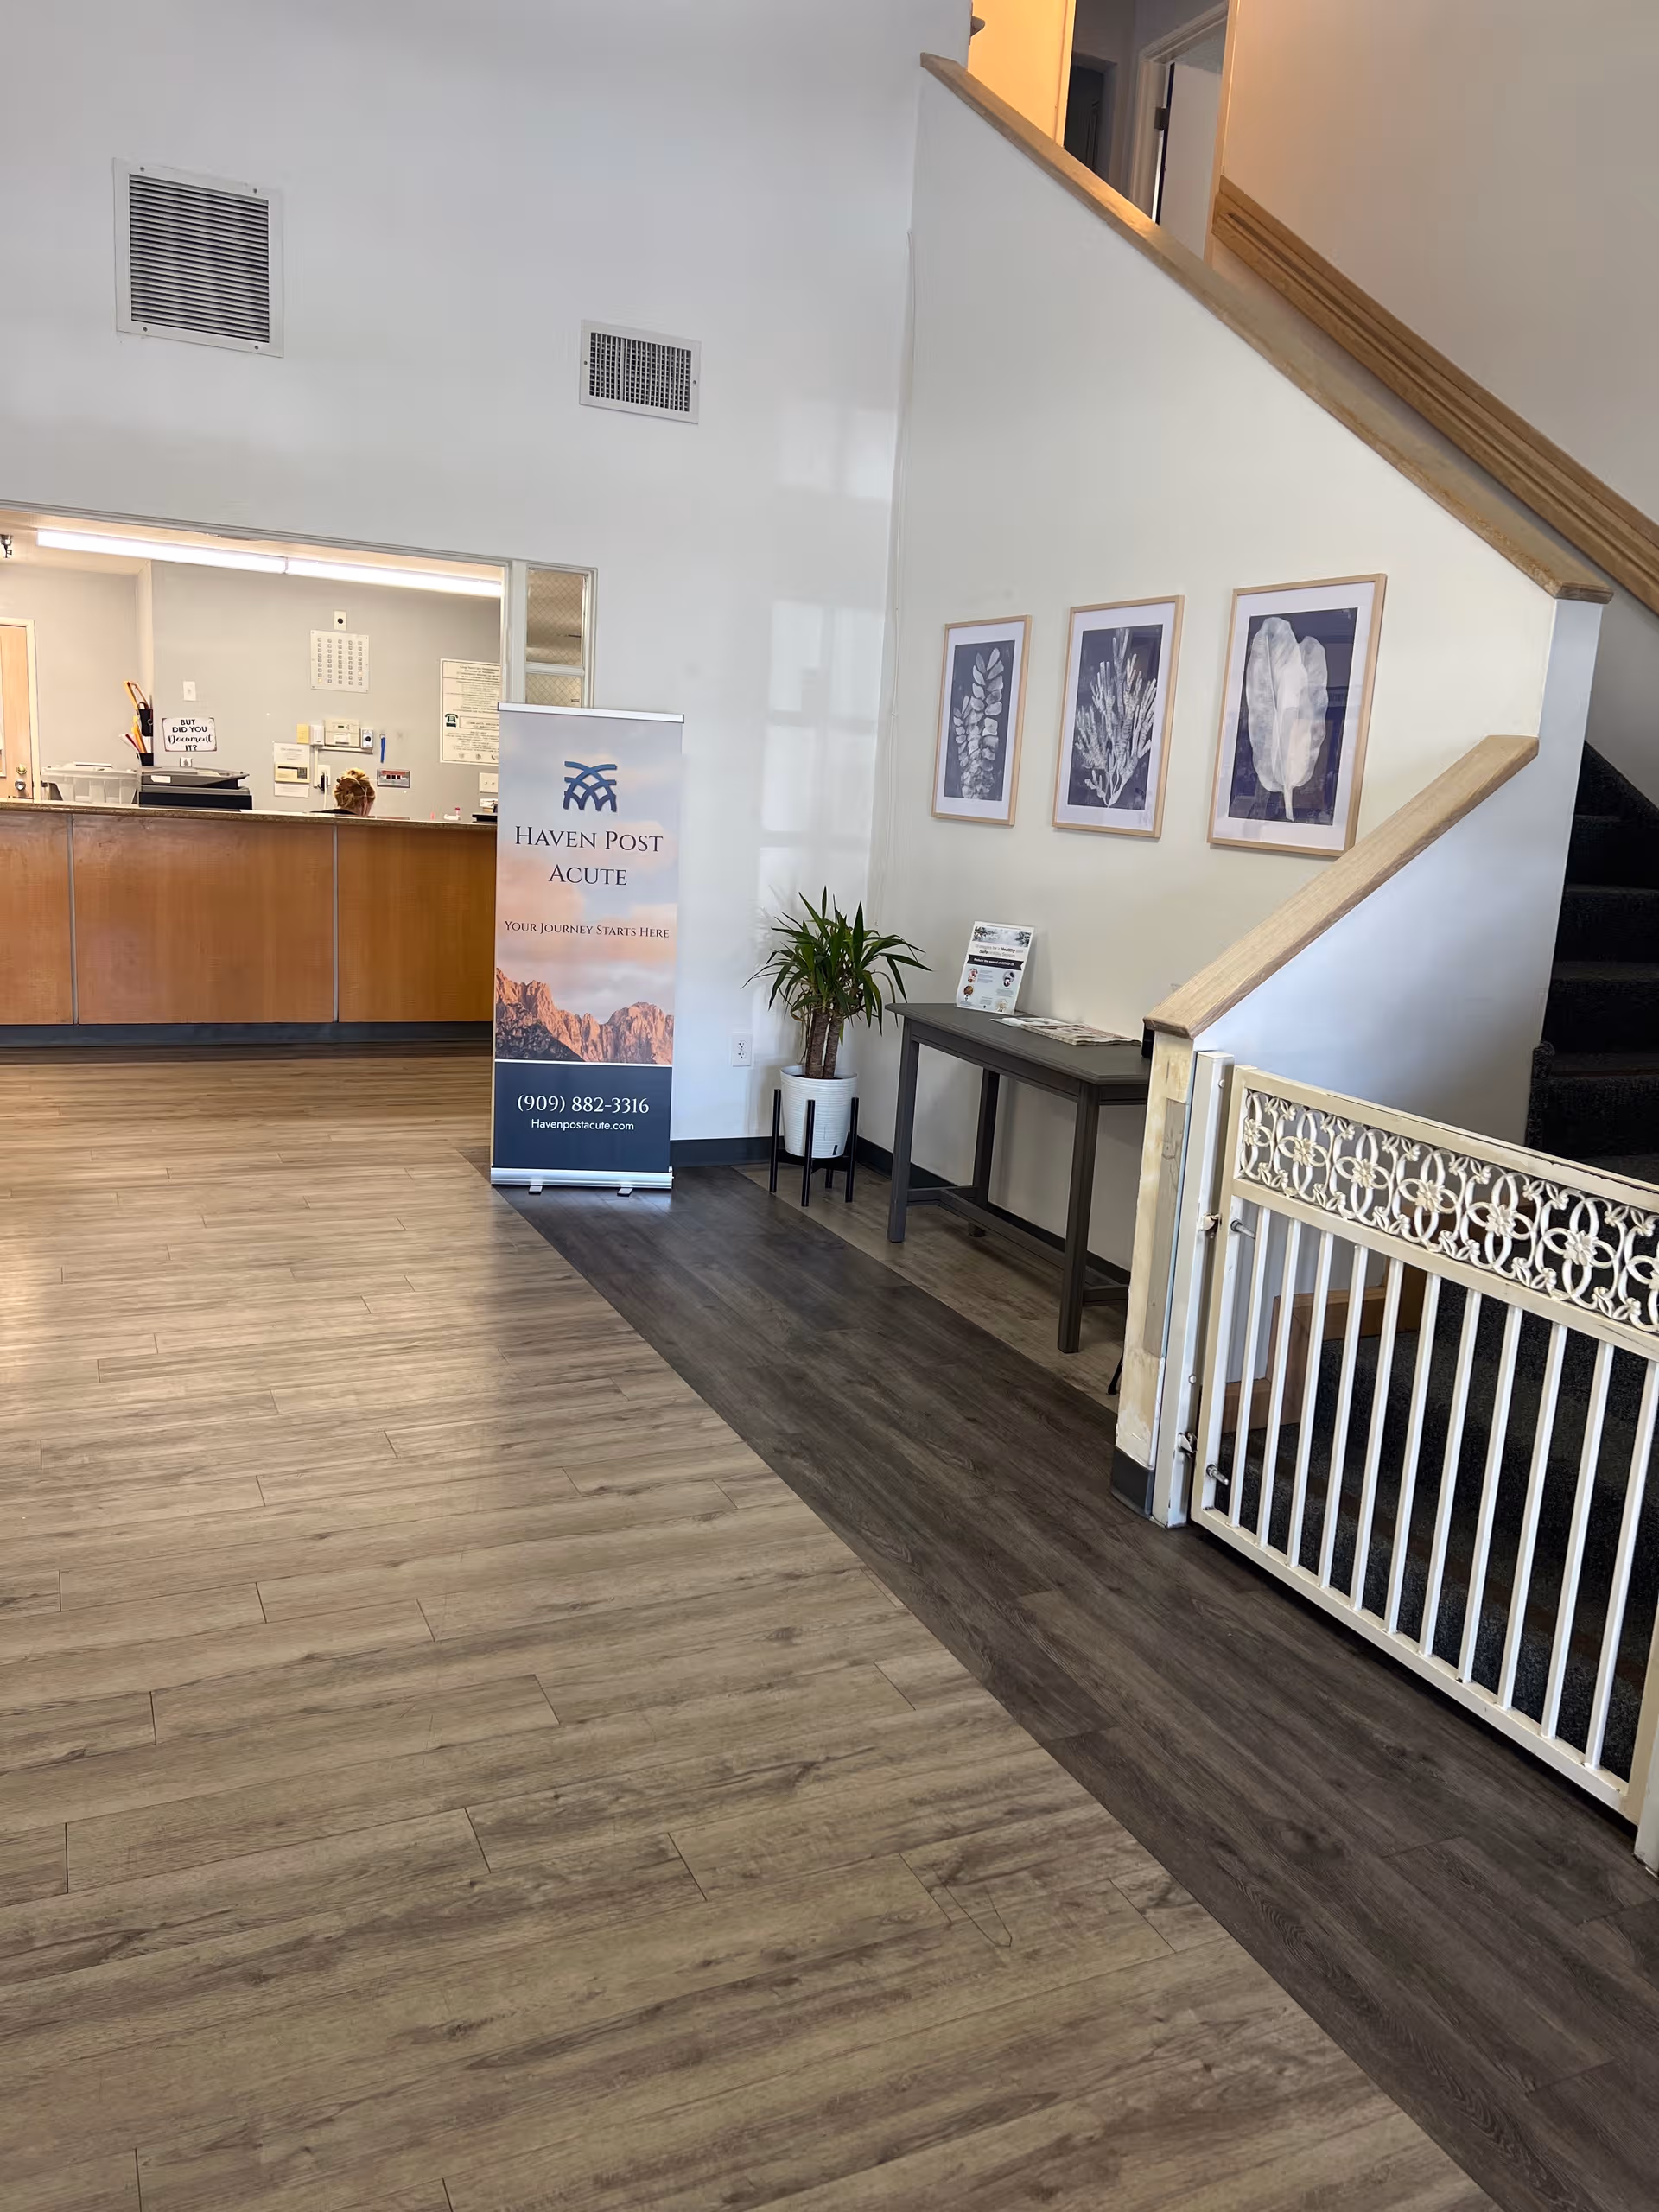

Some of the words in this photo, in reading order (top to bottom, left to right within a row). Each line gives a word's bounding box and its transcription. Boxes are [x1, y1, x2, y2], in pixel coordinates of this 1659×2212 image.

[168, 734, 213, 744] Document
[515, 825, 597, 849] HAVEN
[605, 830, 664, 852] POST
[548, 864, 627, 886] ACUTE
[505, 920, 537, 932] YOUR
[540, 922, 594, 935] JOURNEY
[596, 925, 637, 937] STARTS
[639, 927, 670, 938] HERE
[518, 1094, 566, 1113] (909)
[571, 1096, 649, 1114] 882-3316
[531, 1118, 634, 1131] Havenpostacute.com
